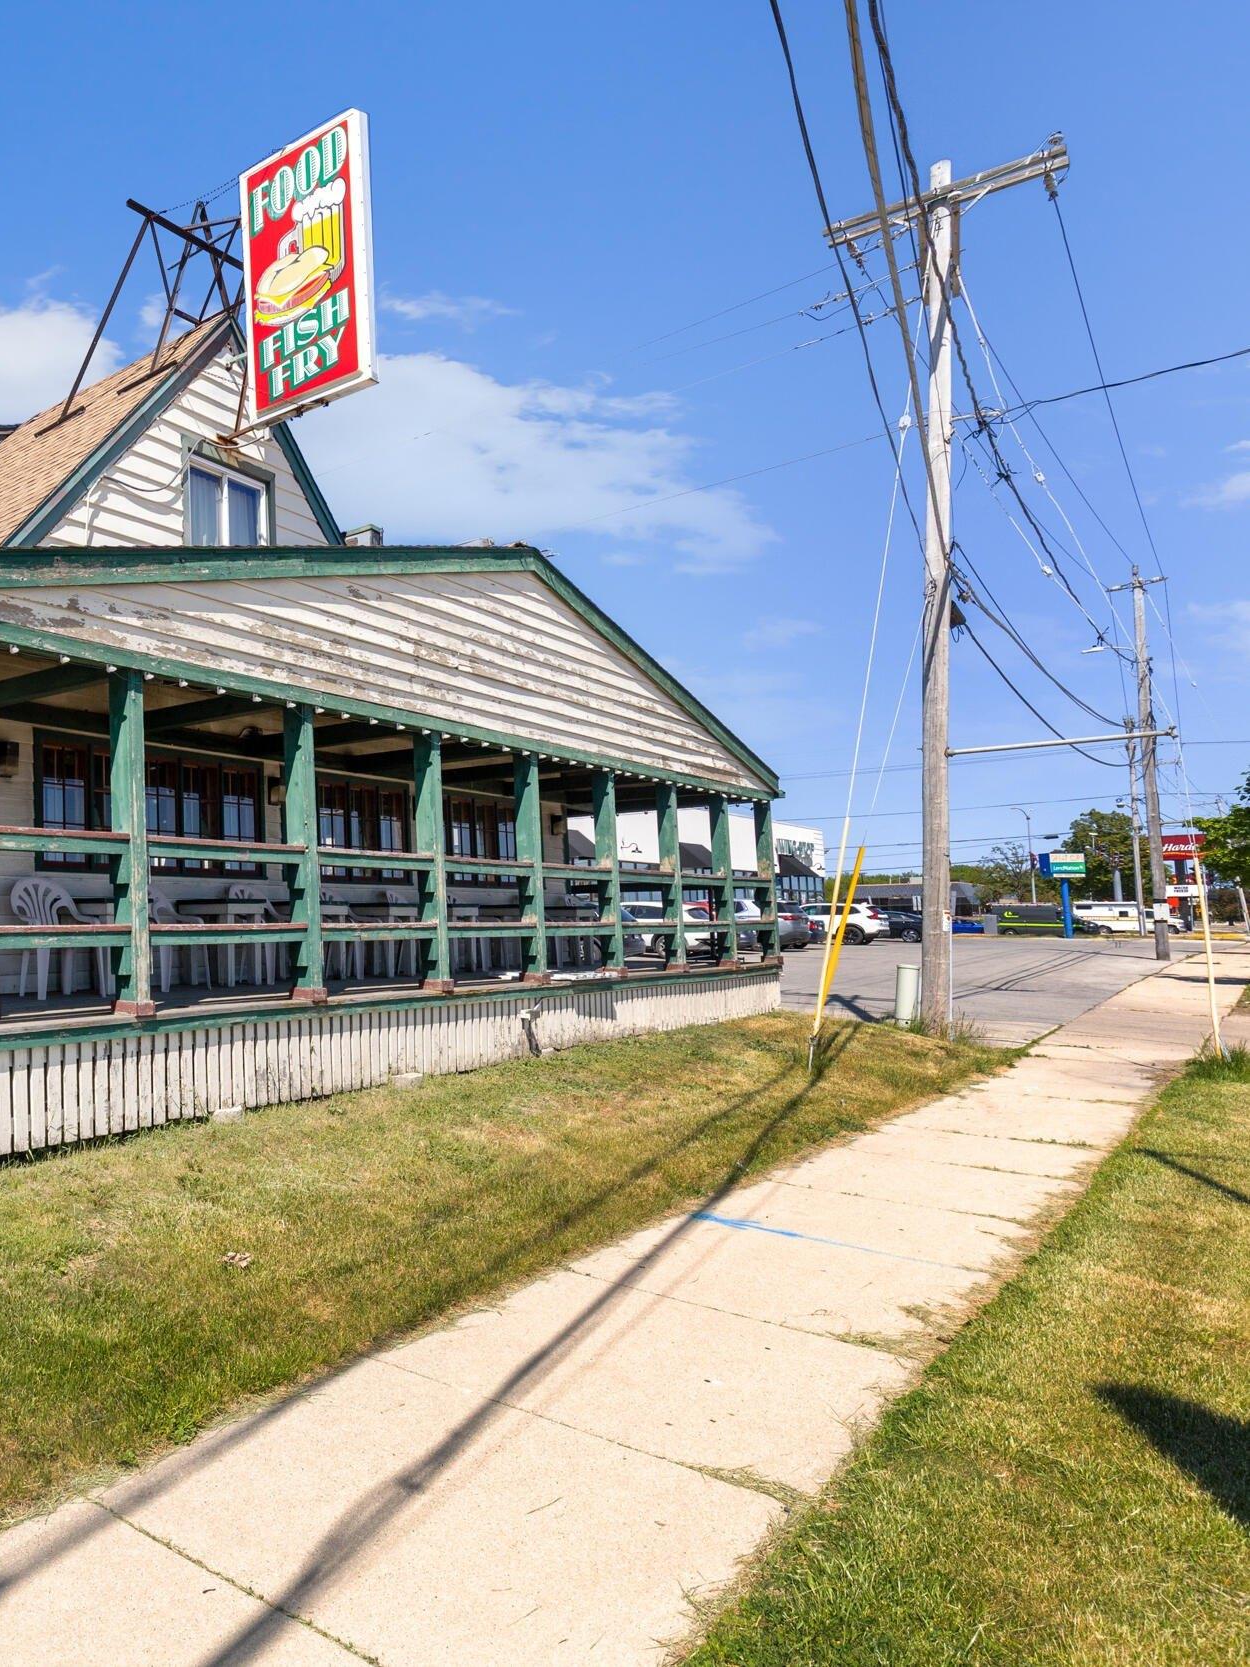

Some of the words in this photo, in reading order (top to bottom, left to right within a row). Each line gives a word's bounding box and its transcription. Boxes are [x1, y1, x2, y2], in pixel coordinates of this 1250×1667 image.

[250, 125, 347, 236] FOOD
[260, 287, 350, 371] FISH
[269, 326, 345, 400] FRY
